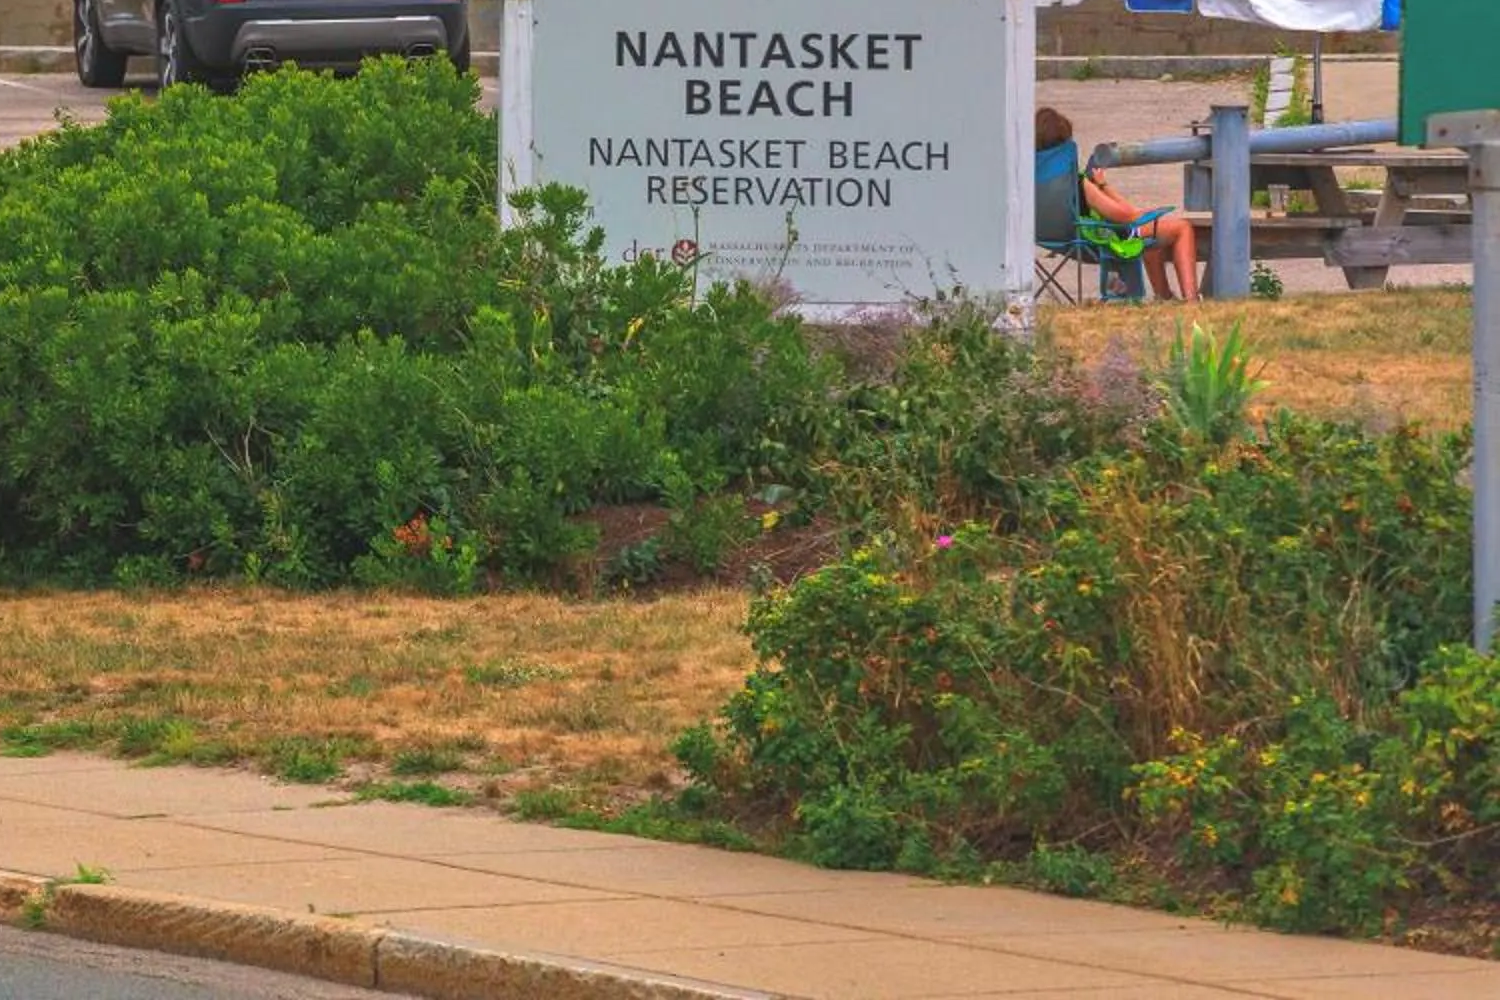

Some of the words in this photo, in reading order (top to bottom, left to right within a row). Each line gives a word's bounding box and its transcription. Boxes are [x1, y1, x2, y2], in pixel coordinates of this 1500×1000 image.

[615, 31, 923, 70] NANTASKET
[685, 80, 854, 117] BEACH
[589, 137, 806, 169] NANTASKET
[829, 141, 949, 171] BEACH
[647, 177, 892, 207] RESERVATION
[805, 259, 832, 267] AND
[835, 260, 913, 269] RECREATION
[813, 243, 894, 253] DEPARTMENT
[899, 245, 915, 254] OF
